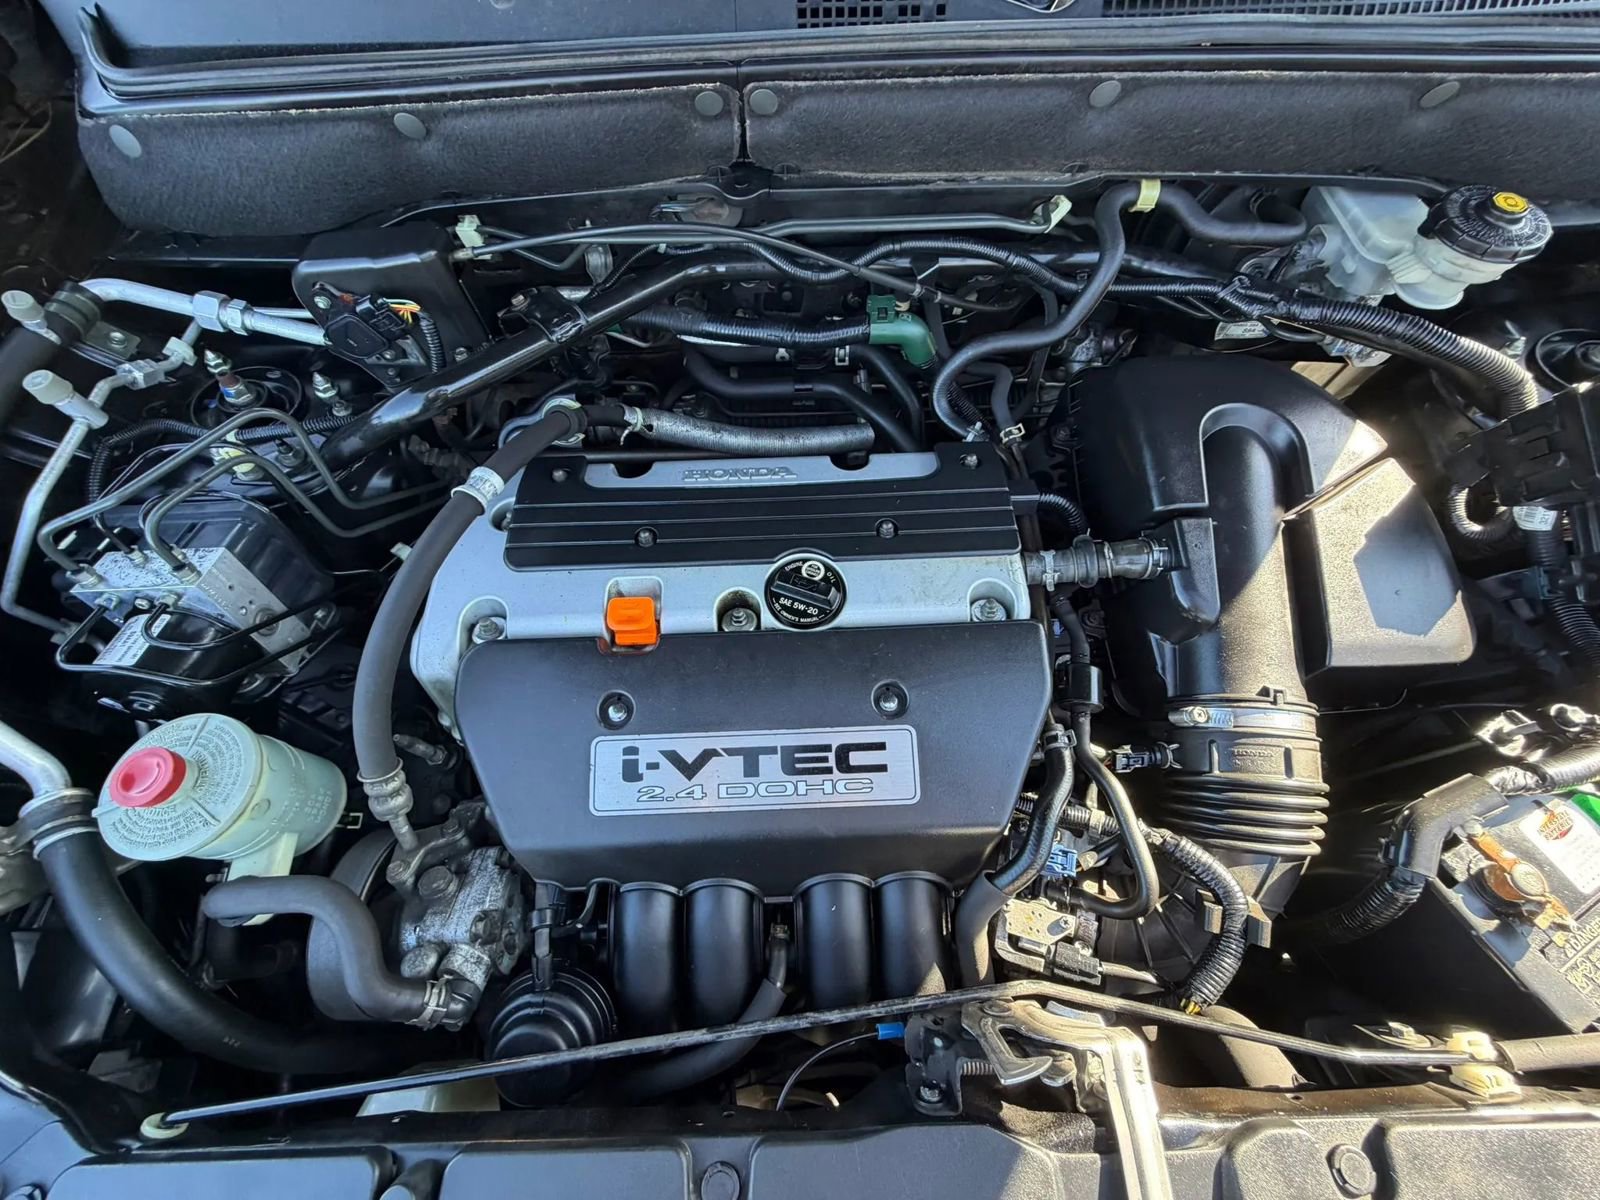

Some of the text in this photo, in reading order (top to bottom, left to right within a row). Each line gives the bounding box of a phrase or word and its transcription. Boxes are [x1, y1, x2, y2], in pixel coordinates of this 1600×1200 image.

[682, 466, 798, 482] HONDA
[784, 561, 803, 571] ENGINE
[826, 571, 836, 583] OIL
[774, 602, 782, 611] SEE
[780, 609, 799, 622] OWNER'S
[779, 597, 818, 615] SAE 5W-20
[622, 741, 888, 783] i-VTEC
[1232, 749, 1275, 757] HONDA
[637, 778, 873, 802] 2.4 DOHC
[1571, 917, 1600, 951] DANGE
